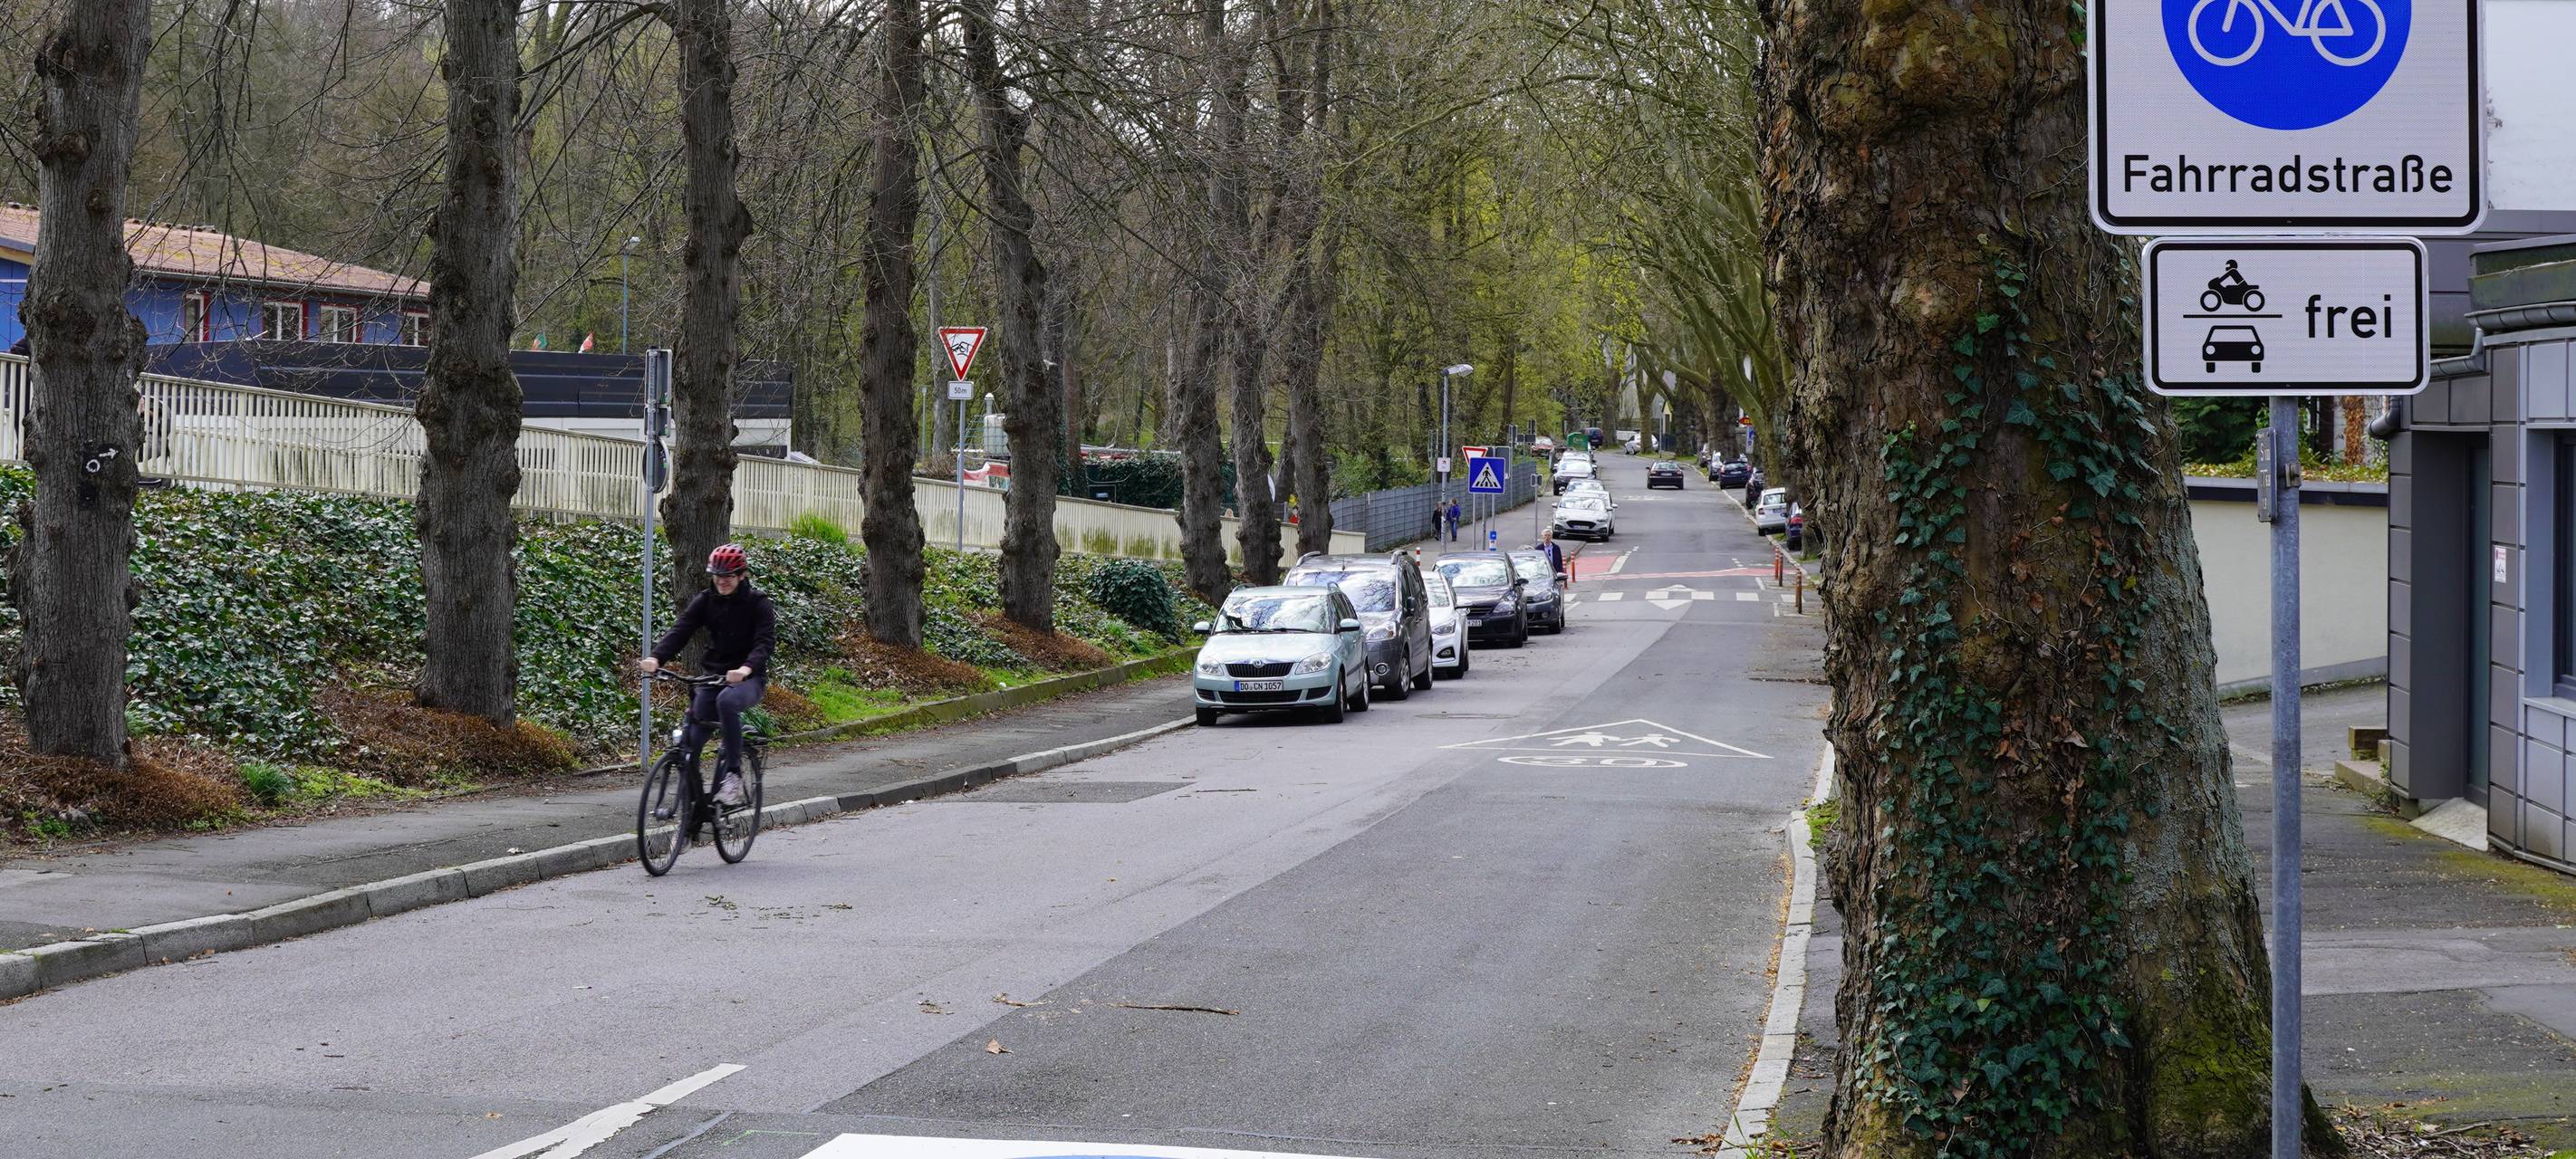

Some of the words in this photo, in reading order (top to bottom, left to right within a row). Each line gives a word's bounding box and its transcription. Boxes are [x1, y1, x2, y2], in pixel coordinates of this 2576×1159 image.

[2124, 154, 2453, 193] Fahrradstraße
[2304, 293, 2392, 339] frei
[1240, 683, 1249, 691] DO
[1264, 682, 1282, 690] 1057
